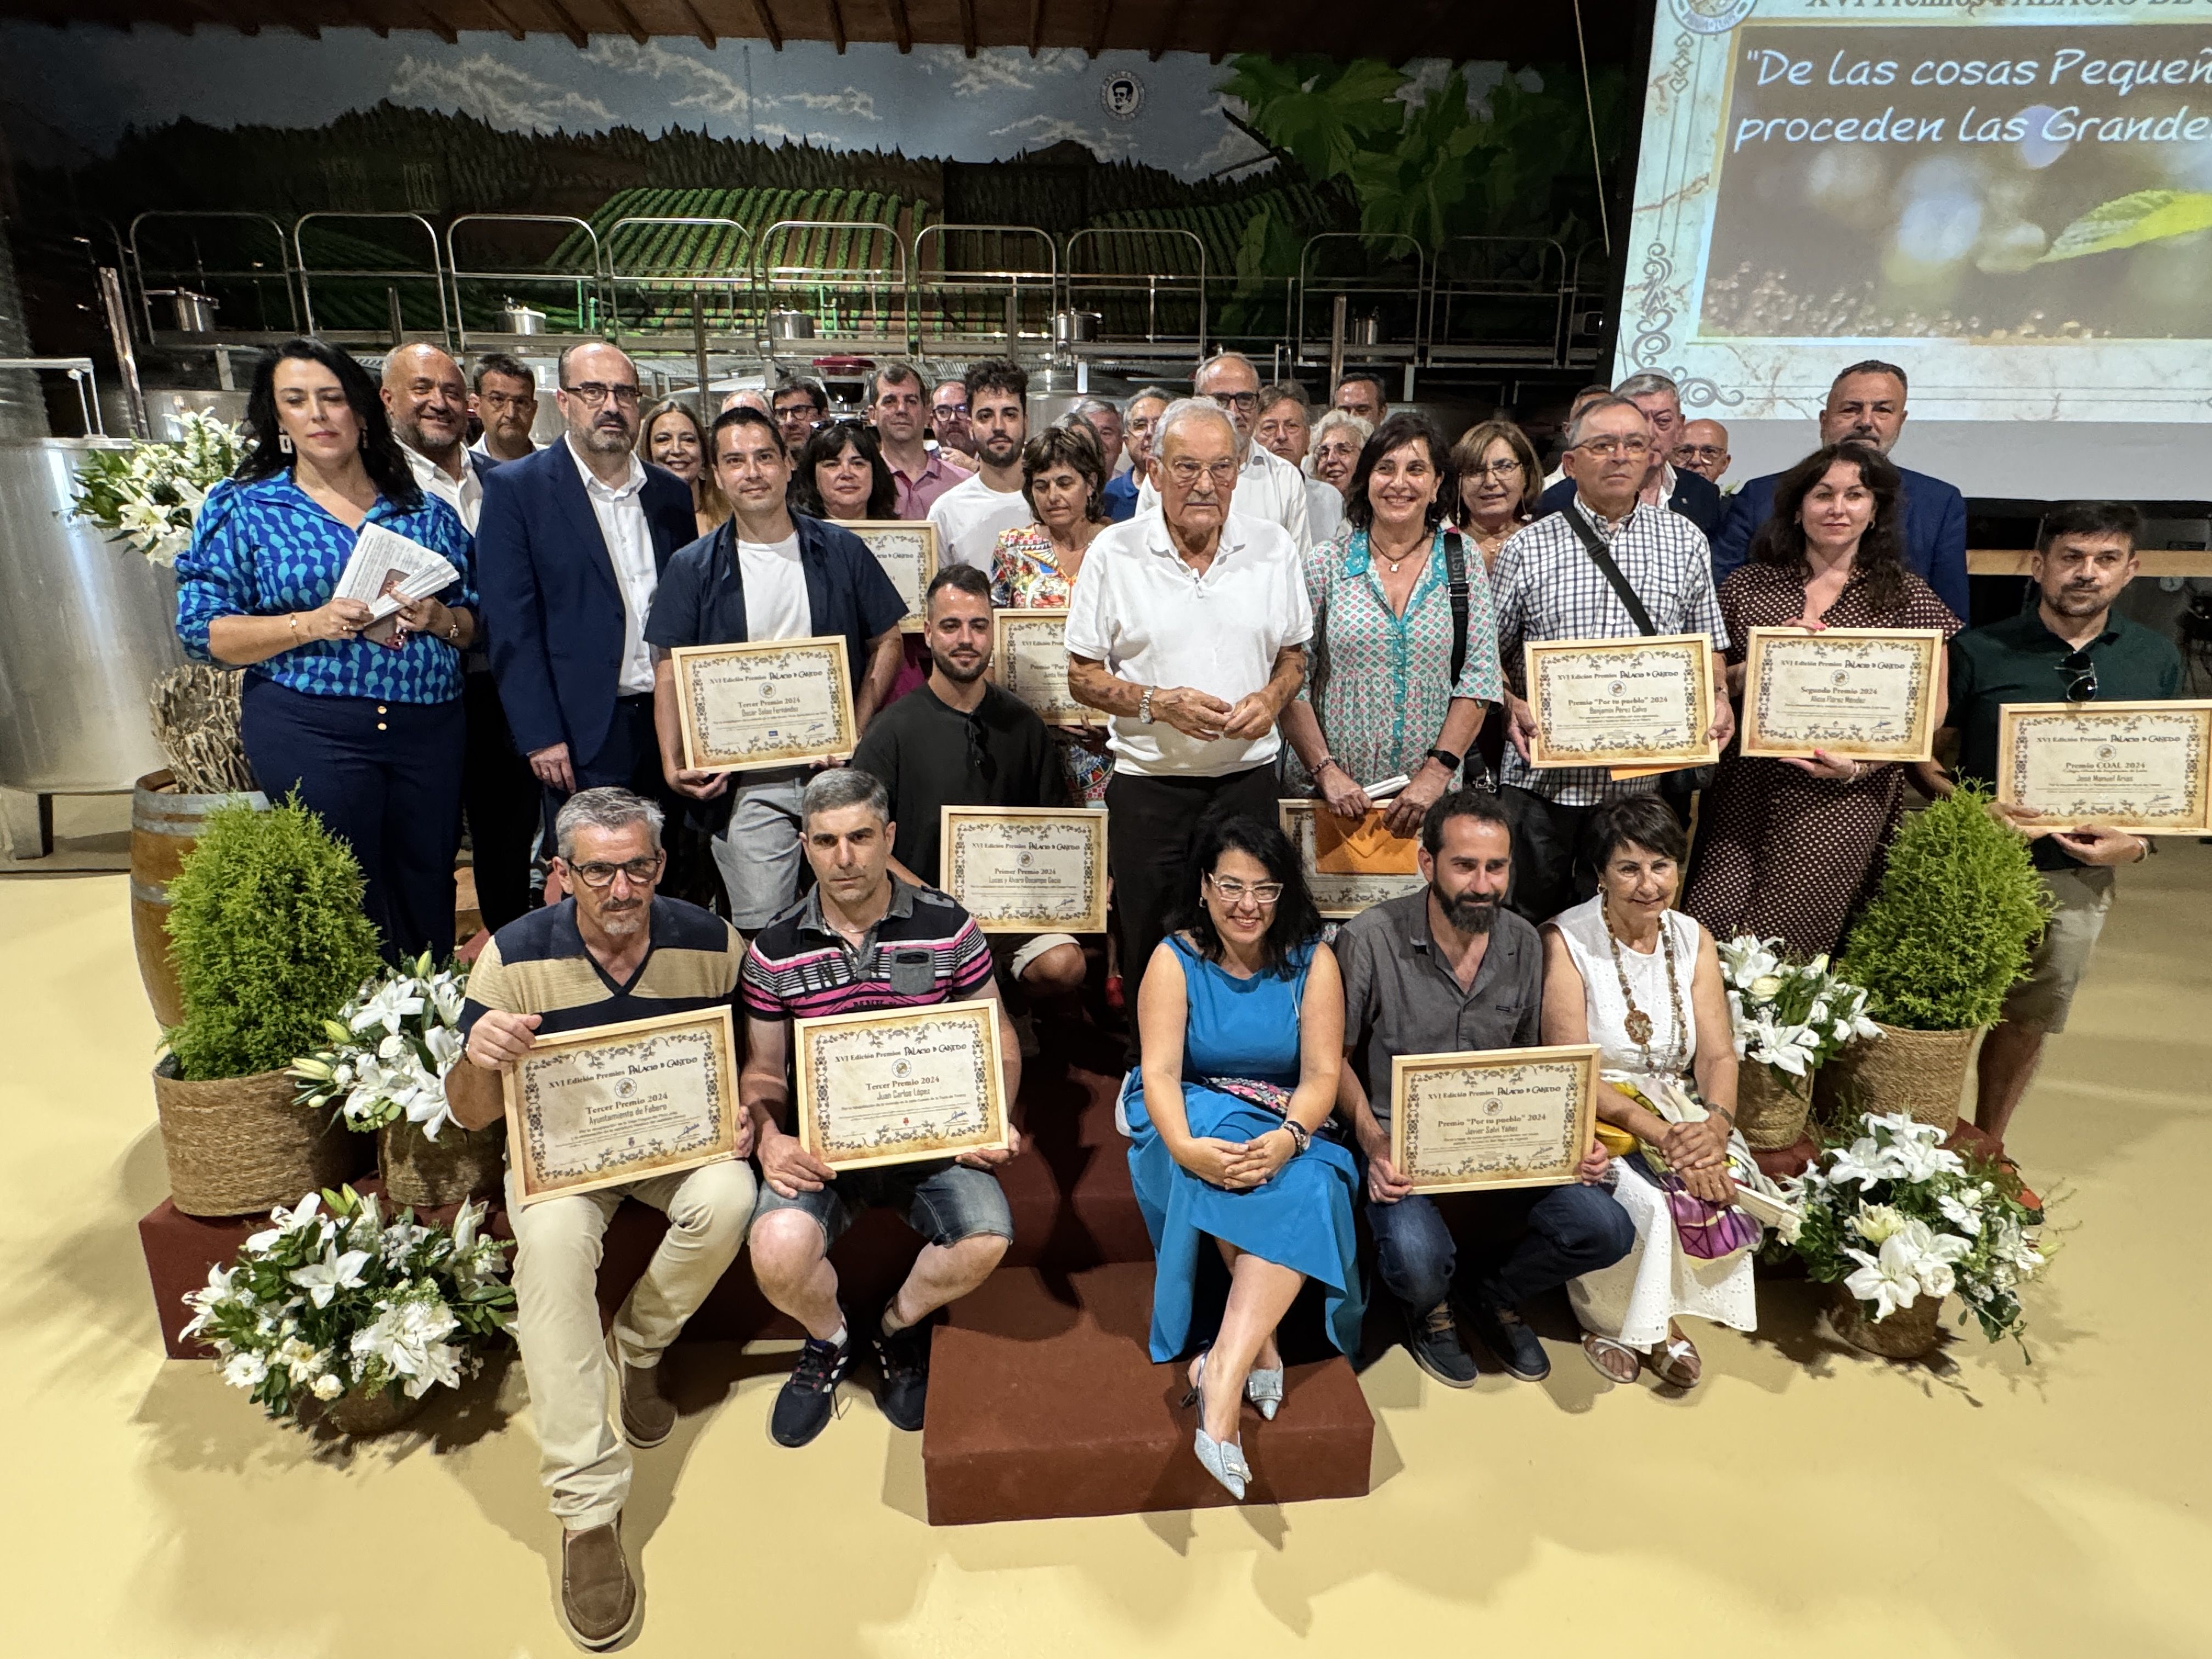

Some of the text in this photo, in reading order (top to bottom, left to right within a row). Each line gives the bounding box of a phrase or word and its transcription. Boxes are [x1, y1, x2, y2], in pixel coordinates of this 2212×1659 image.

[1747, 49, 1813, 86] "De
[1827, 49, 1899, 86] las
[1910, 59, 2039, 86] cosas
[1734, 105, 2212, 154] proceden las Grande
[1844, 659, 1870, 668] PALACIO
[769, 672, 792, 680] PALACIO
[1620, 670, 1644, 679] PALACIO
[1801, 686, 1831, 695] Segundo
[2111, 734, 2140, 743] PALACIO
[1028, 842, 1050, 850] PALACIO
[850, 1053, 874, 1061] Edición
[876, 1050, 901, 1058] Premios
[904, 1046, 930, 1056] PALACIO
[938, 1043, 967, 1053] CANEDO
[549, 1080, 565, 1088] XVI
[567, 1075, 595, 1085] Edición
[596, 1070, 625, 1080] Premios
[628, 1064, 658, 1075] PALACIO
[666, 1057, 698, 1069] CANEDO
[866, 1075, 940, 1091] Tercer Premio 2024
[877, 1092, 891, 1101] Juan
[893, 1090, 912, 1099] Carlos
[1497, 1087, 1524, 1096] PALACIO
[1532, 1086, 1561, 1094] CANEDO
[586, 1092, 668, 1115] Tercer Premio 2024
[589, 1103, 667, 1125] Ayuntamiento de Fabero
